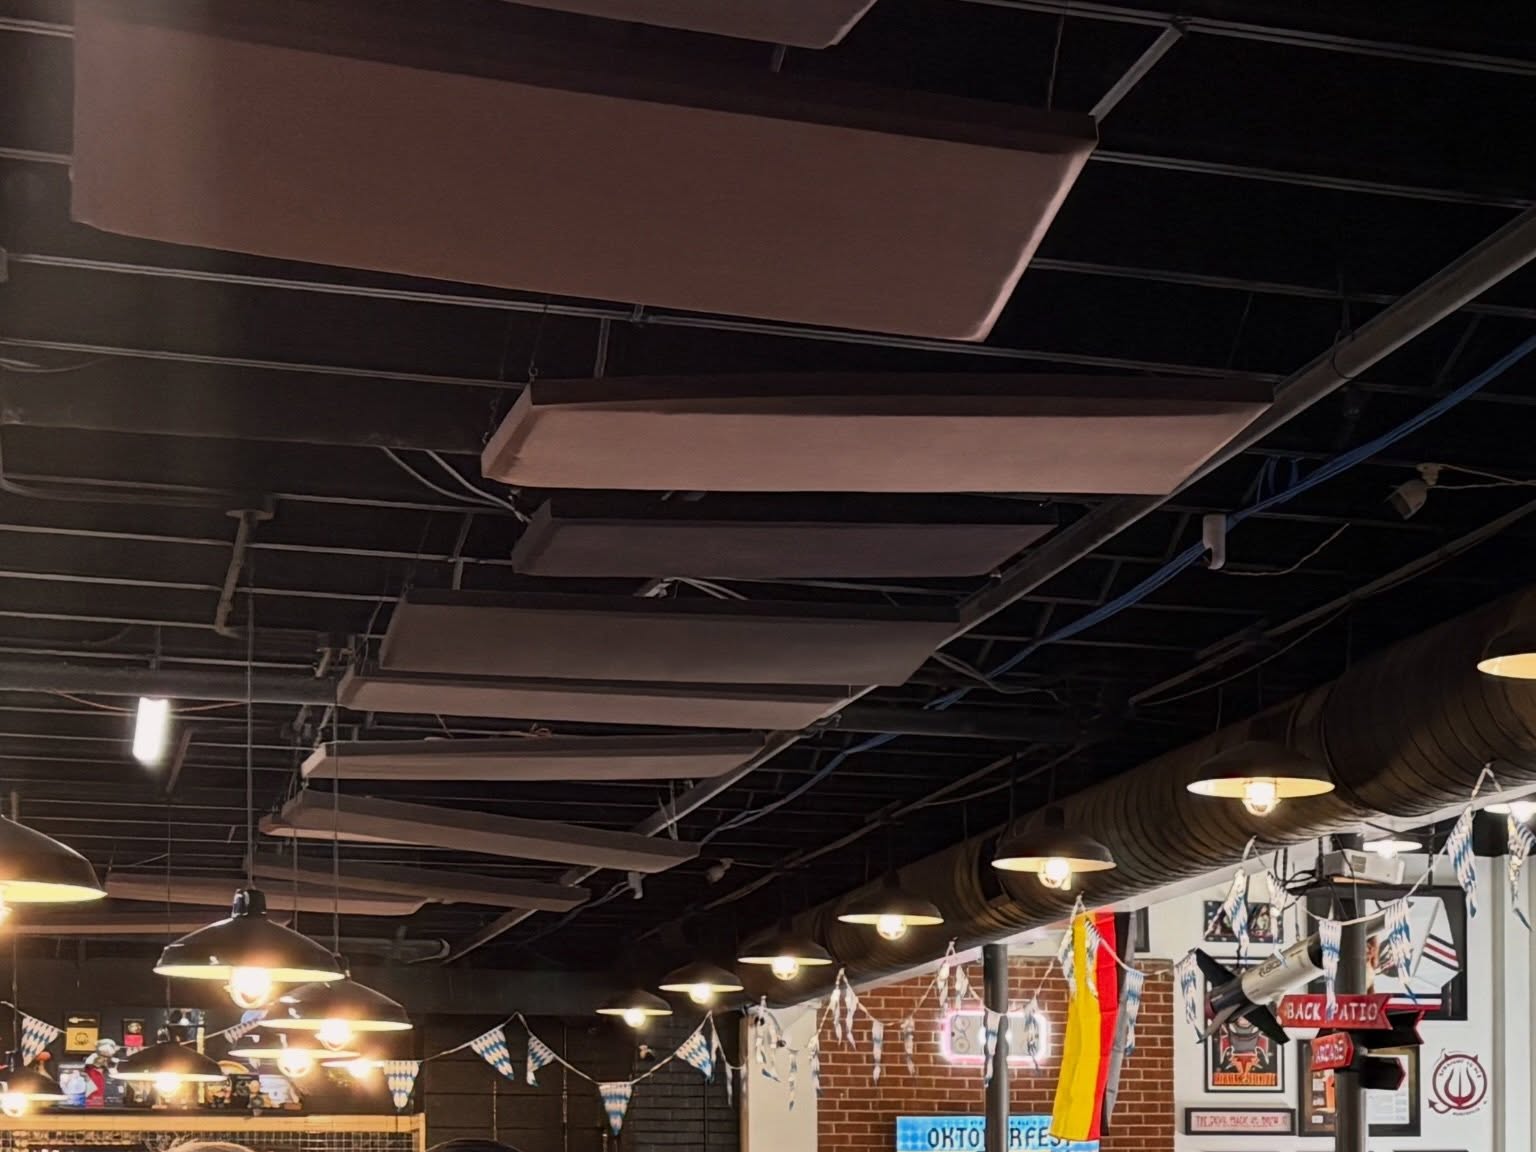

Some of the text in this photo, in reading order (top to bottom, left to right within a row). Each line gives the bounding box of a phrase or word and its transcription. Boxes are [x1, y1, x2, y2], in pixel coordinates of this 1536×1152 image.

[1286, 1002, 1378, 1021] BACK PATIO
[1315, 1039, 1345, 1063] ARCADE
